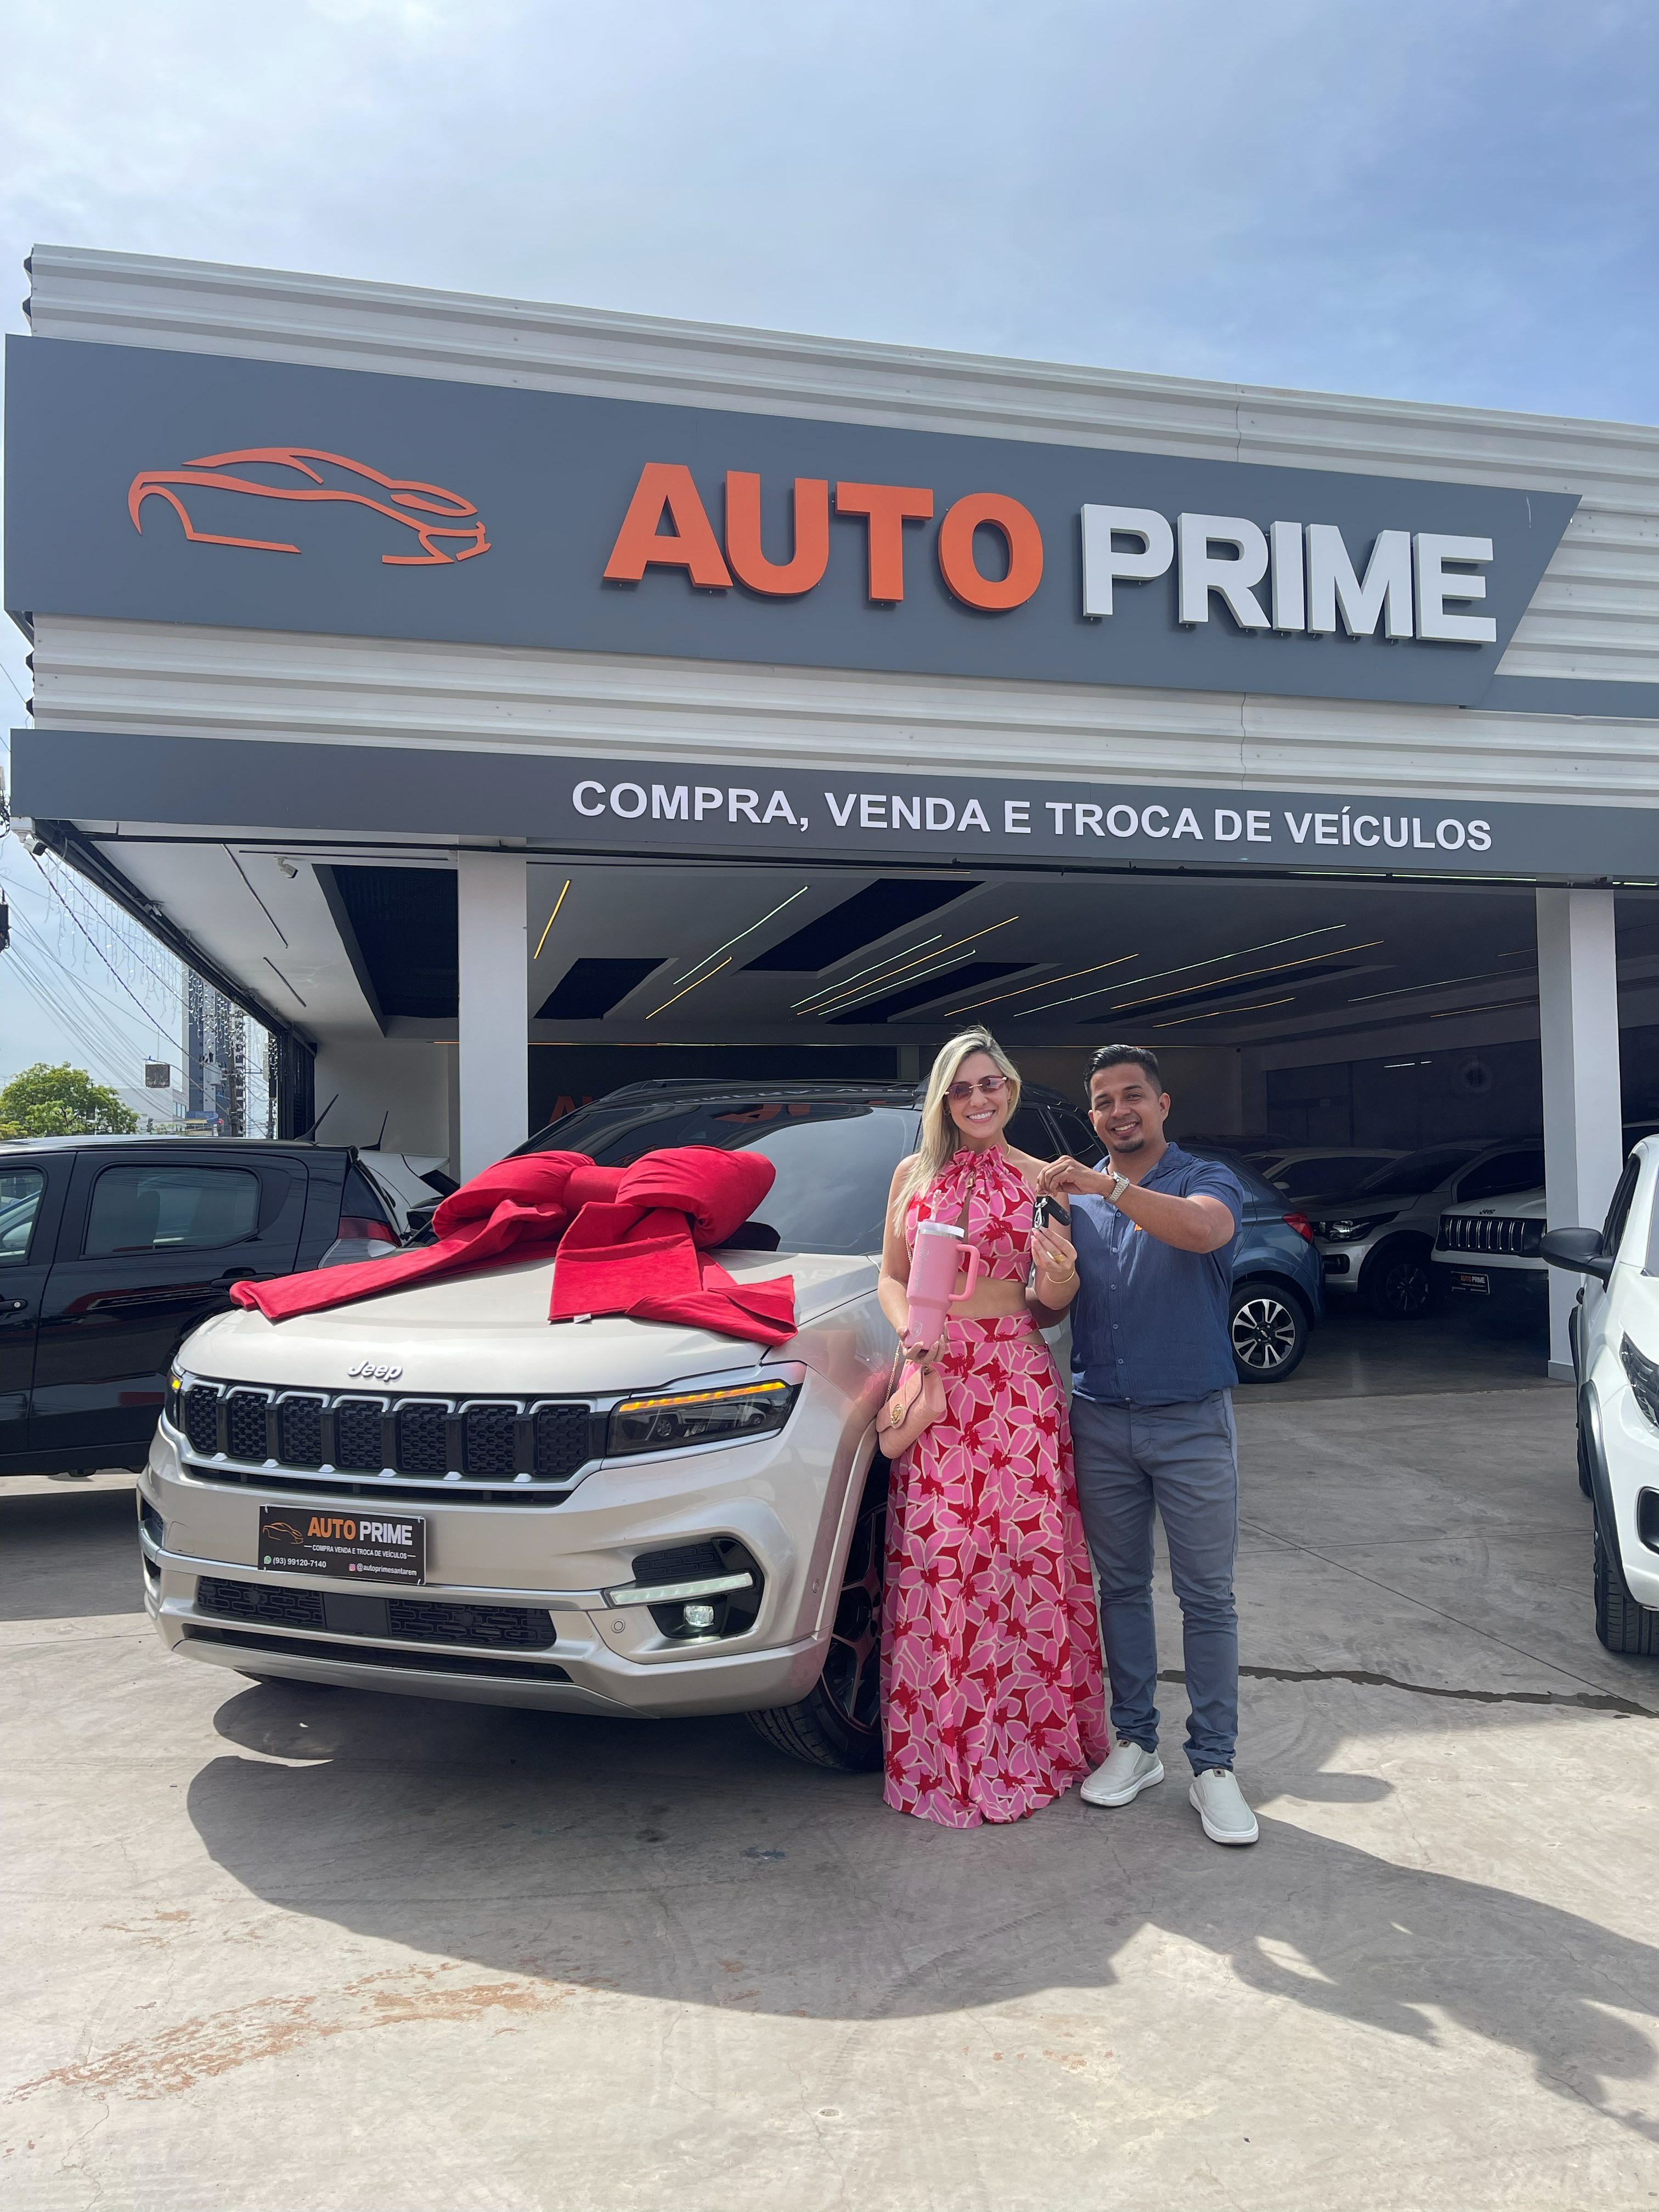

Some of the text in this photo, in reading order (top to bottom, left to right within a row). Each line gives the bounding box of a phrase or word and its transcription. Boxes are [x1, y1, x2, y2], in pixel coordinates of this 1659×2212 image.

[602, 462, 1497, 643] AUTO PRIME
[572, 780, 1492, 851] COMPRA, VENDA E TROCA DE VEÍCULOS
[347, 1360, 403, 1382] Jeep
[307, 1517, 413, 1545] AUTO PRIME
[273, 1557, 326, 1568] (93) 99120-7140
[357, 1548, 374, 1556] TROCA
[356, 1563, 417, 1576] @autoprimesantarem
